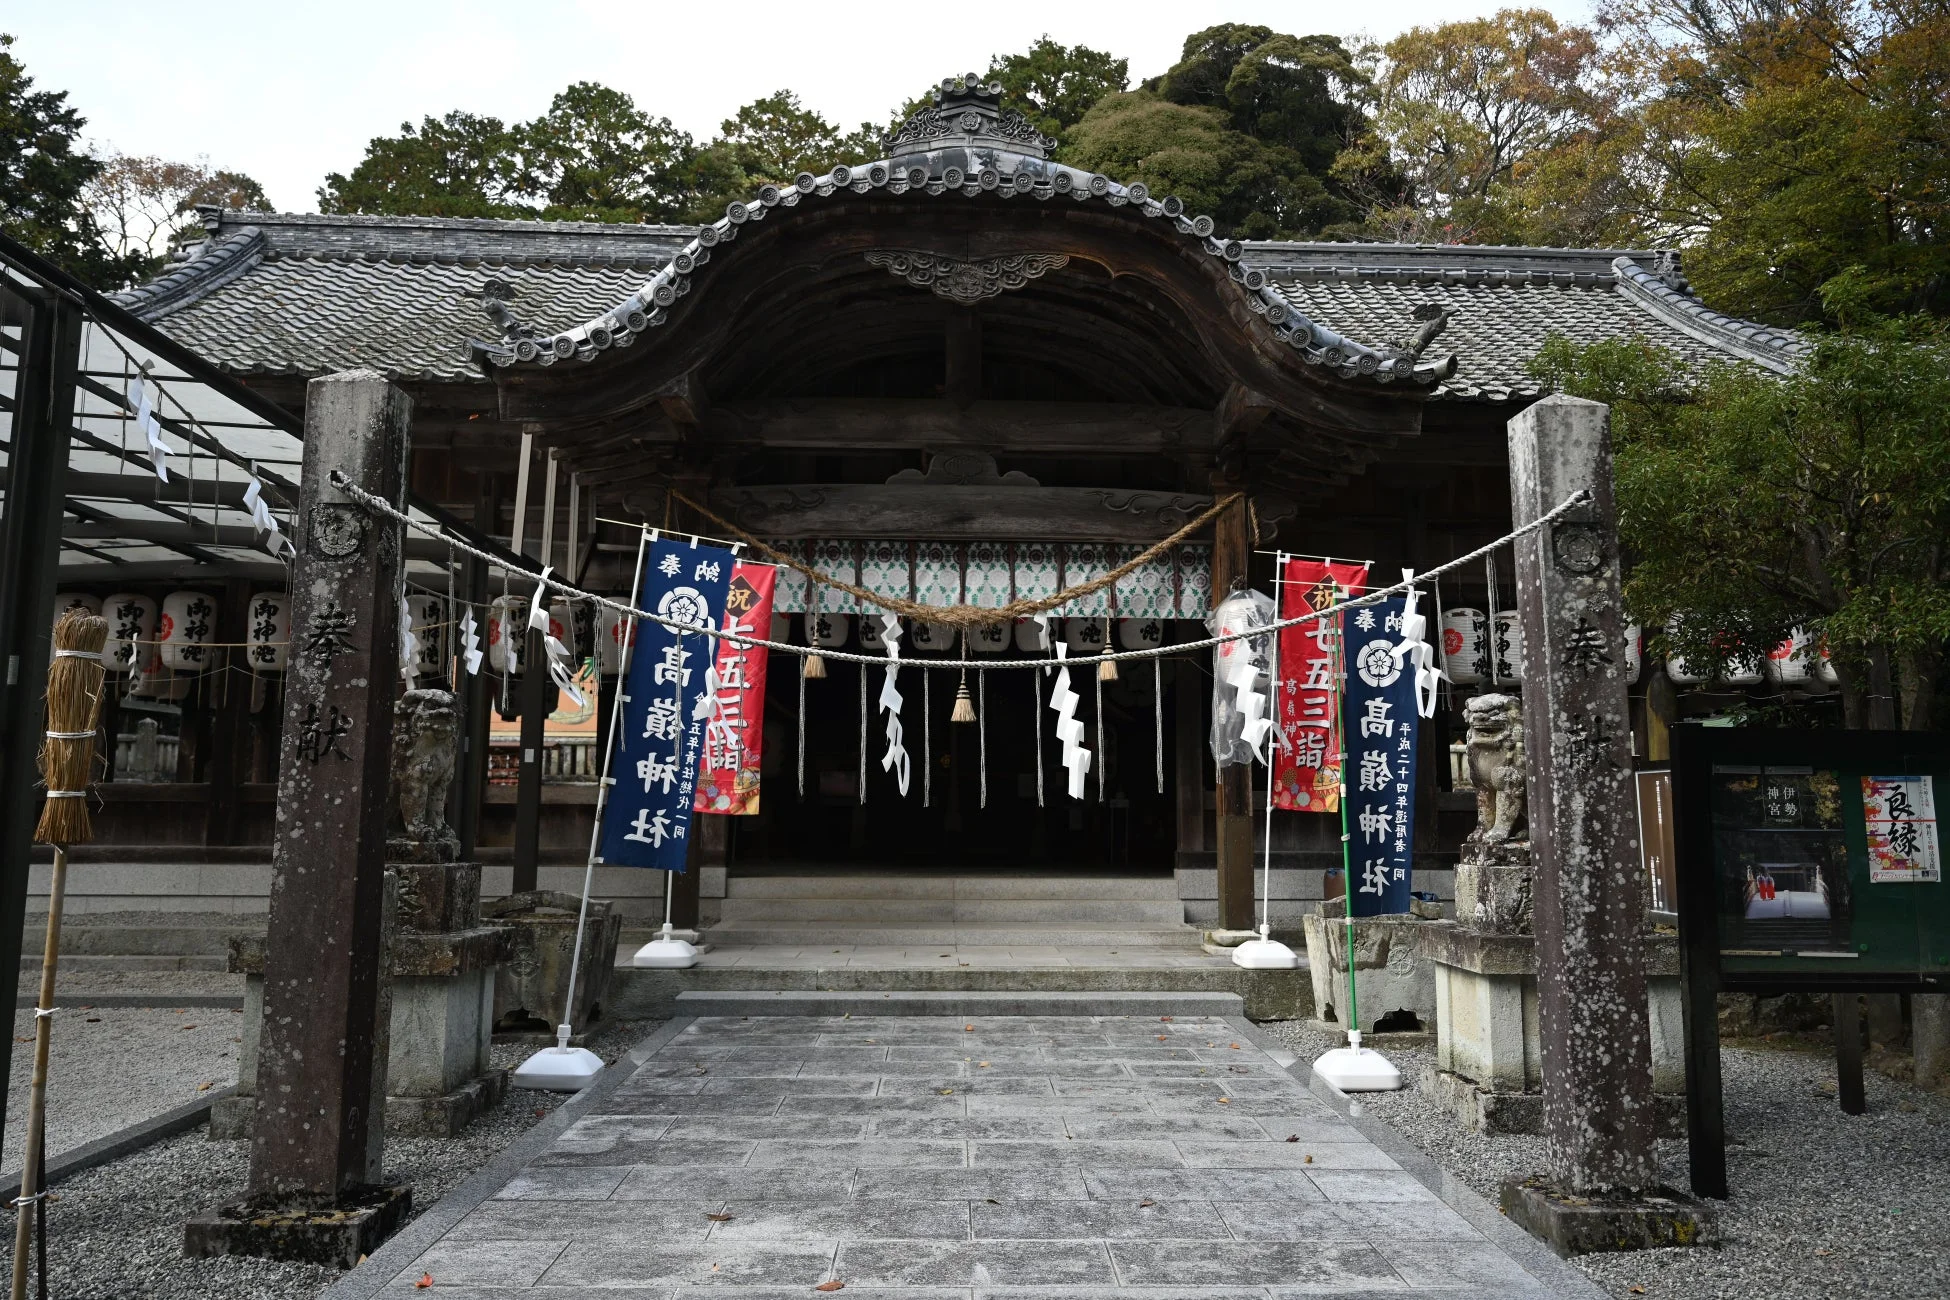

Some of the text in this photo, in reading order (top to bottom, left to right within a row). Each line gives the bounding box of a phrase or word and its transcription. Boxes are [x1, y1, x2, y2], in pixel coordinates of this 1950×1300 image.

[726, 584, 752, 611] 祝
[1295, 617, 1341, 769] 七五三詣
